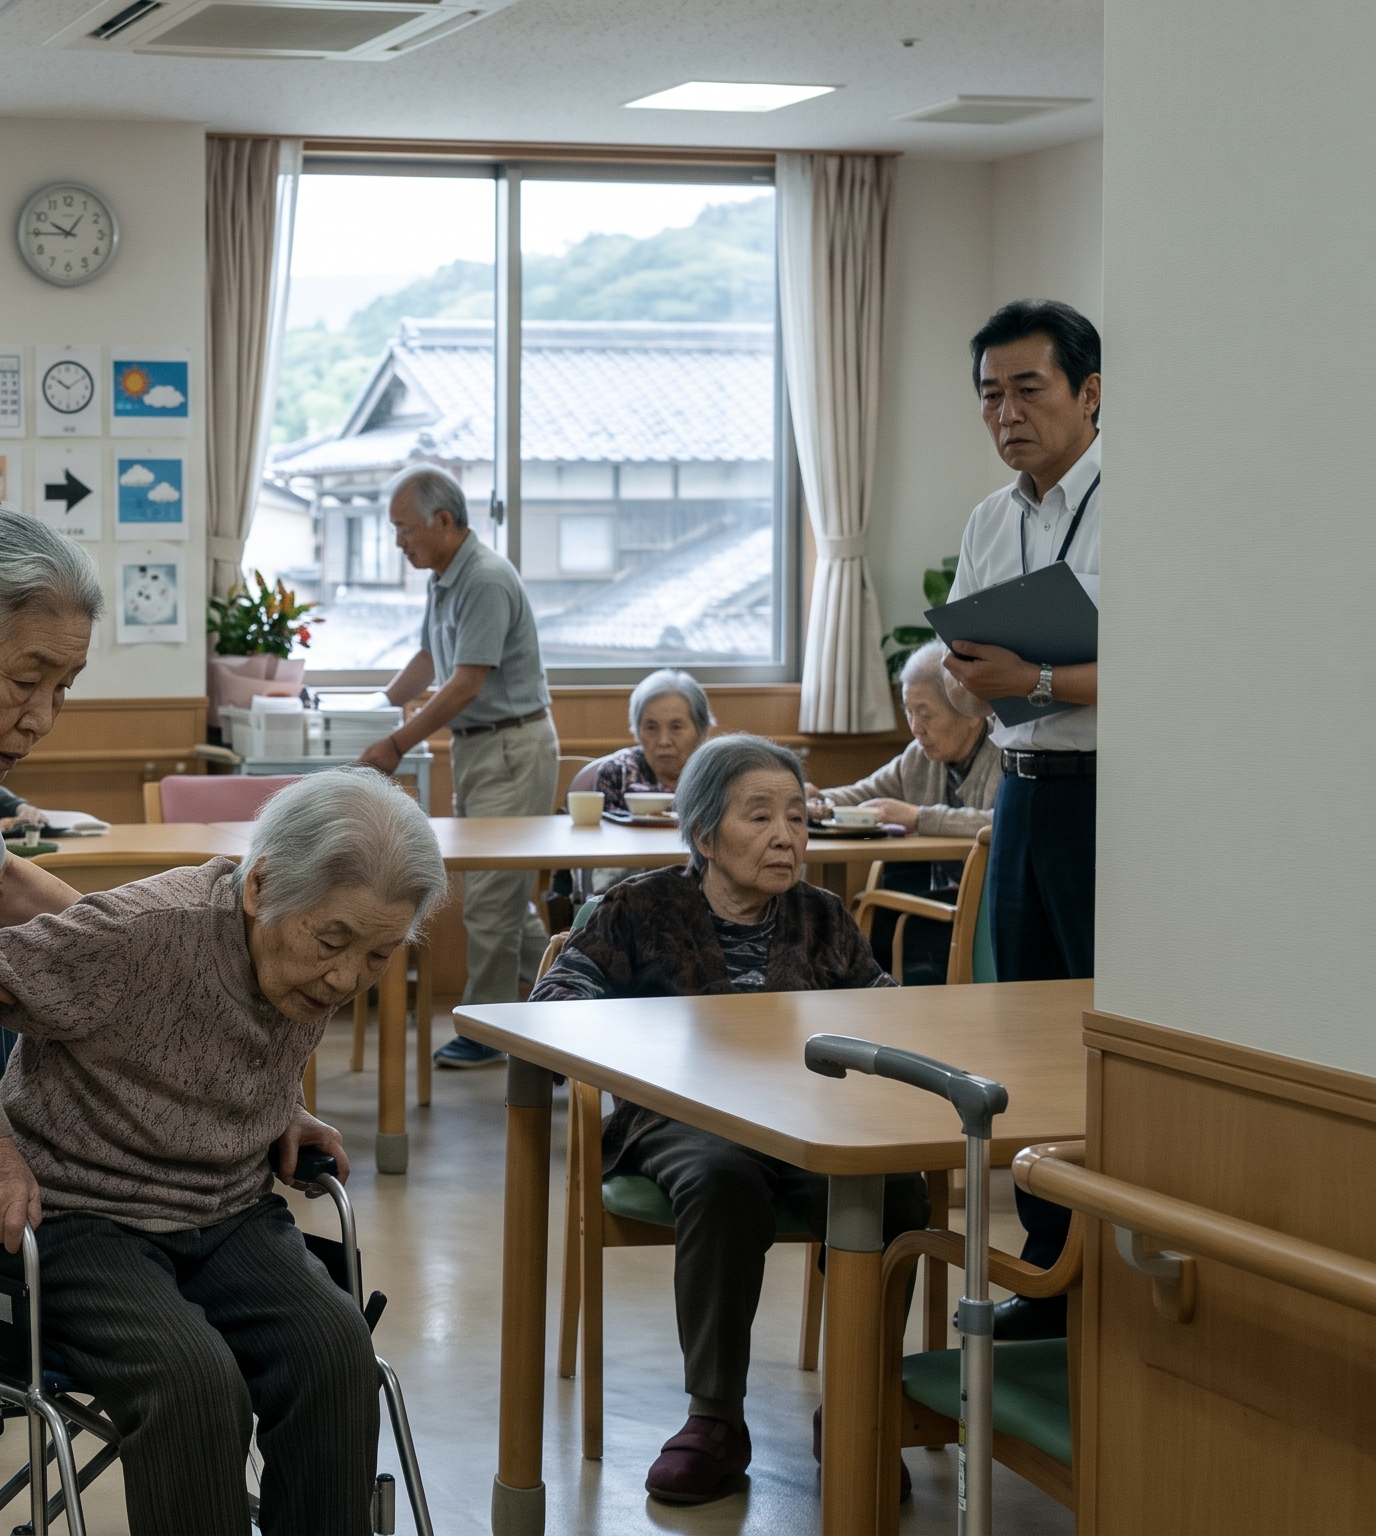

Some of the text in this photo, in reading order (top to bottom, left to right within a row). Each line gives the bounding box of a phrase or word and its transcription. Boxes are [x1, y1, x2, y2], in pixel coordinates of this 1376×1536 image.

[48, 200, 57, 210] 11
[63, 195, 74, 207] 12
[82, 201, 87, 211] 1
[34, 211, 47, 223] 10
[92, 213, 100, 224] 2
[97, 230, 105, 241] 3
[37, 244, 44, 255] 8
[92, 246, 99, 255] 4
[49, 257, 56, 267] 7
[64, 261, 72, 272] 6
[81, 257, 88, 268] 5
